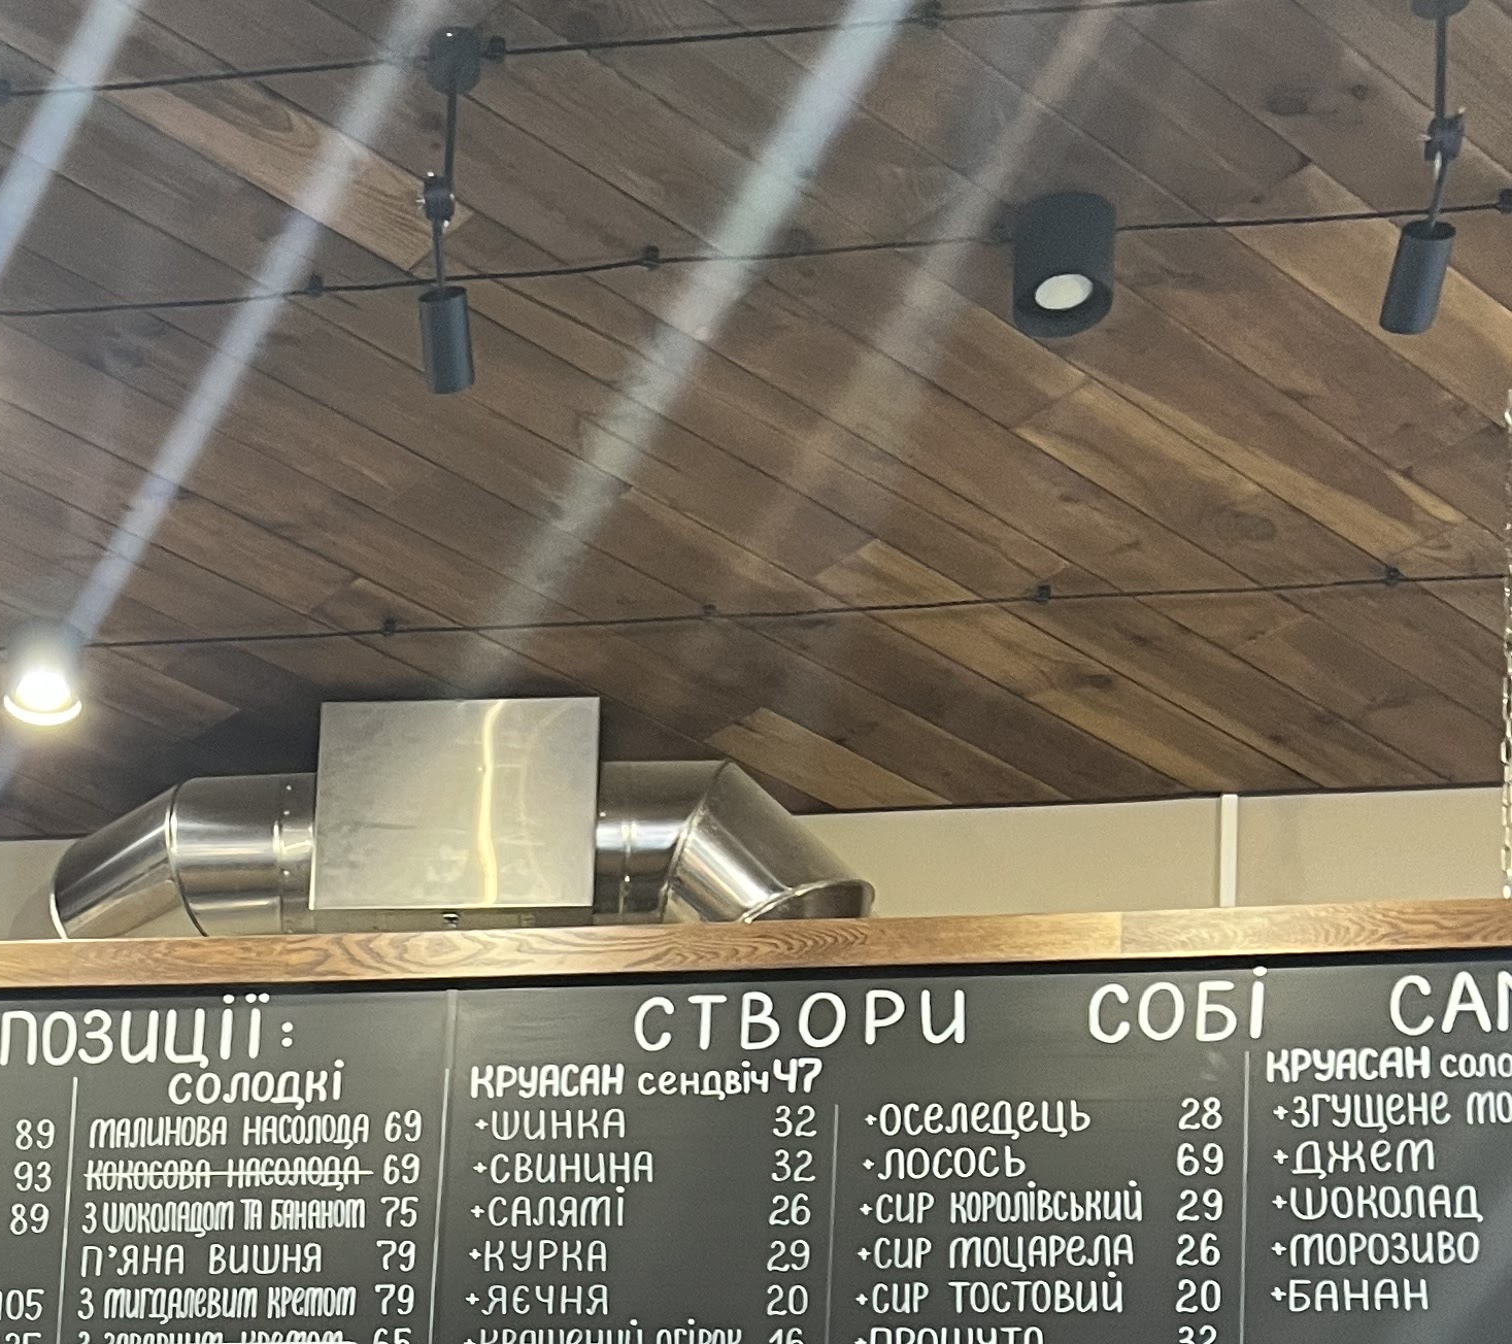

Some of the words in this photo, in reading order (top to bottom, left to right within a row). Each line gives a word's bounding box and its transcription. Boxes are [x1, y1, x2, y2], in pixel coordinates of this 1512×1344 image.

[635, 990, 964, 1051] СТВОРИ
[1089, 967, 1267, 1043] СОБІ
[471, 1064, 624, 1098] КРУАСАН
[638, 1061, 768, 1100] сендвіч
[774, 1058, 822, 1093] 47
[1267, 1046, 1430, 1082] КРУАСАН
[167, 1059, 345, 1110] солодкі
[90, 1116, 227, 1148] МАЛИНОВА
[243, 1114, 369, 1149] НАСОЛОДА
[773, 1106, 816, 1137] 32
[103, 1201, 234, 1237] ШОКОЛАДОМ
[271, 1199, 365, 1230] БАНАНОМ
[381, 1197, 418, 1227] 75
[951, 1180, 1142, 1223] КОРОЛІВСЬКИЙ
[209, 1243, 321, 1274] ВИШНЯ
[950, 1234, 1133, 1272] МОЦАРЕЛА
[104, 1288, 257, 1324] МИГДАЛЕВИМ
[268, 1287, 356, 1318] КРЕМОМ
[948, 1272, 1122, 1313] ТОСТОВИЙ
